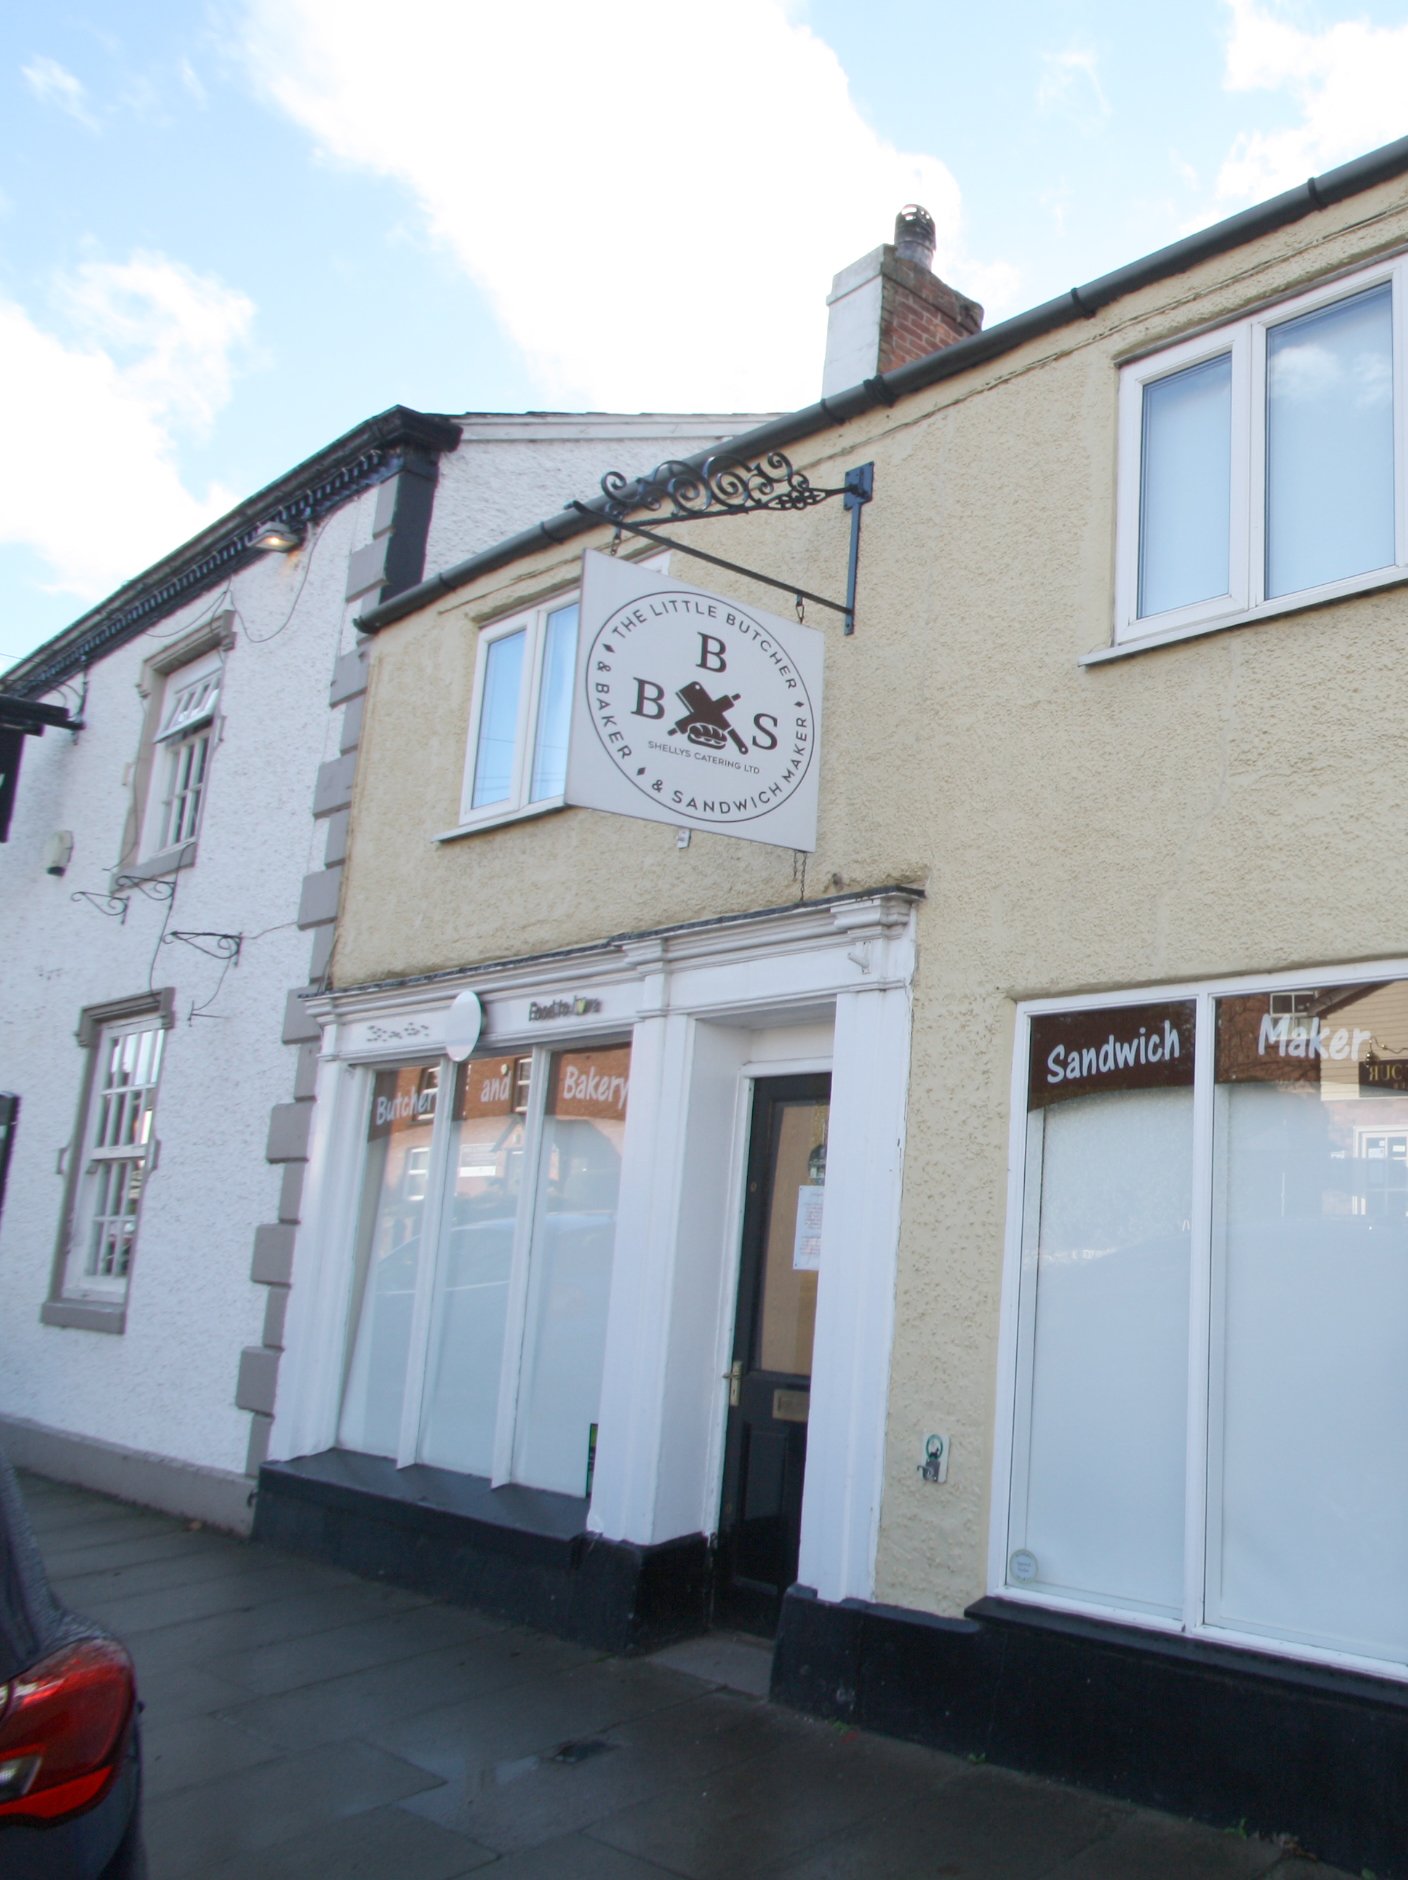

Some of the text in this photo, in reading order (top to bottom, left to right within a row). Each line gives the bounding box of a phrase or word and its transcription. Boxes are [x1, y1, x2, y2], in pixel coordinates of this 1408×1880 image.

[612, 600, 797, 690] THE LITTLE BUTCHER
[696, 632, 728, 673] B
[595, 660, 632, 760] & BAKER
[631, 677, 779, 751] B S
[647, 740, 760, 775] SHELLYS CATERING LTD
[651, 716, 808, 815] & SANDWICH MAKER
[1046, 1020, 1180, 1084] Sandwich
[1257, 1013, 1371, 1062] Maker
[480, 1073, 512, 1103] and
[563, 1065, 630, 1111] Bakery
